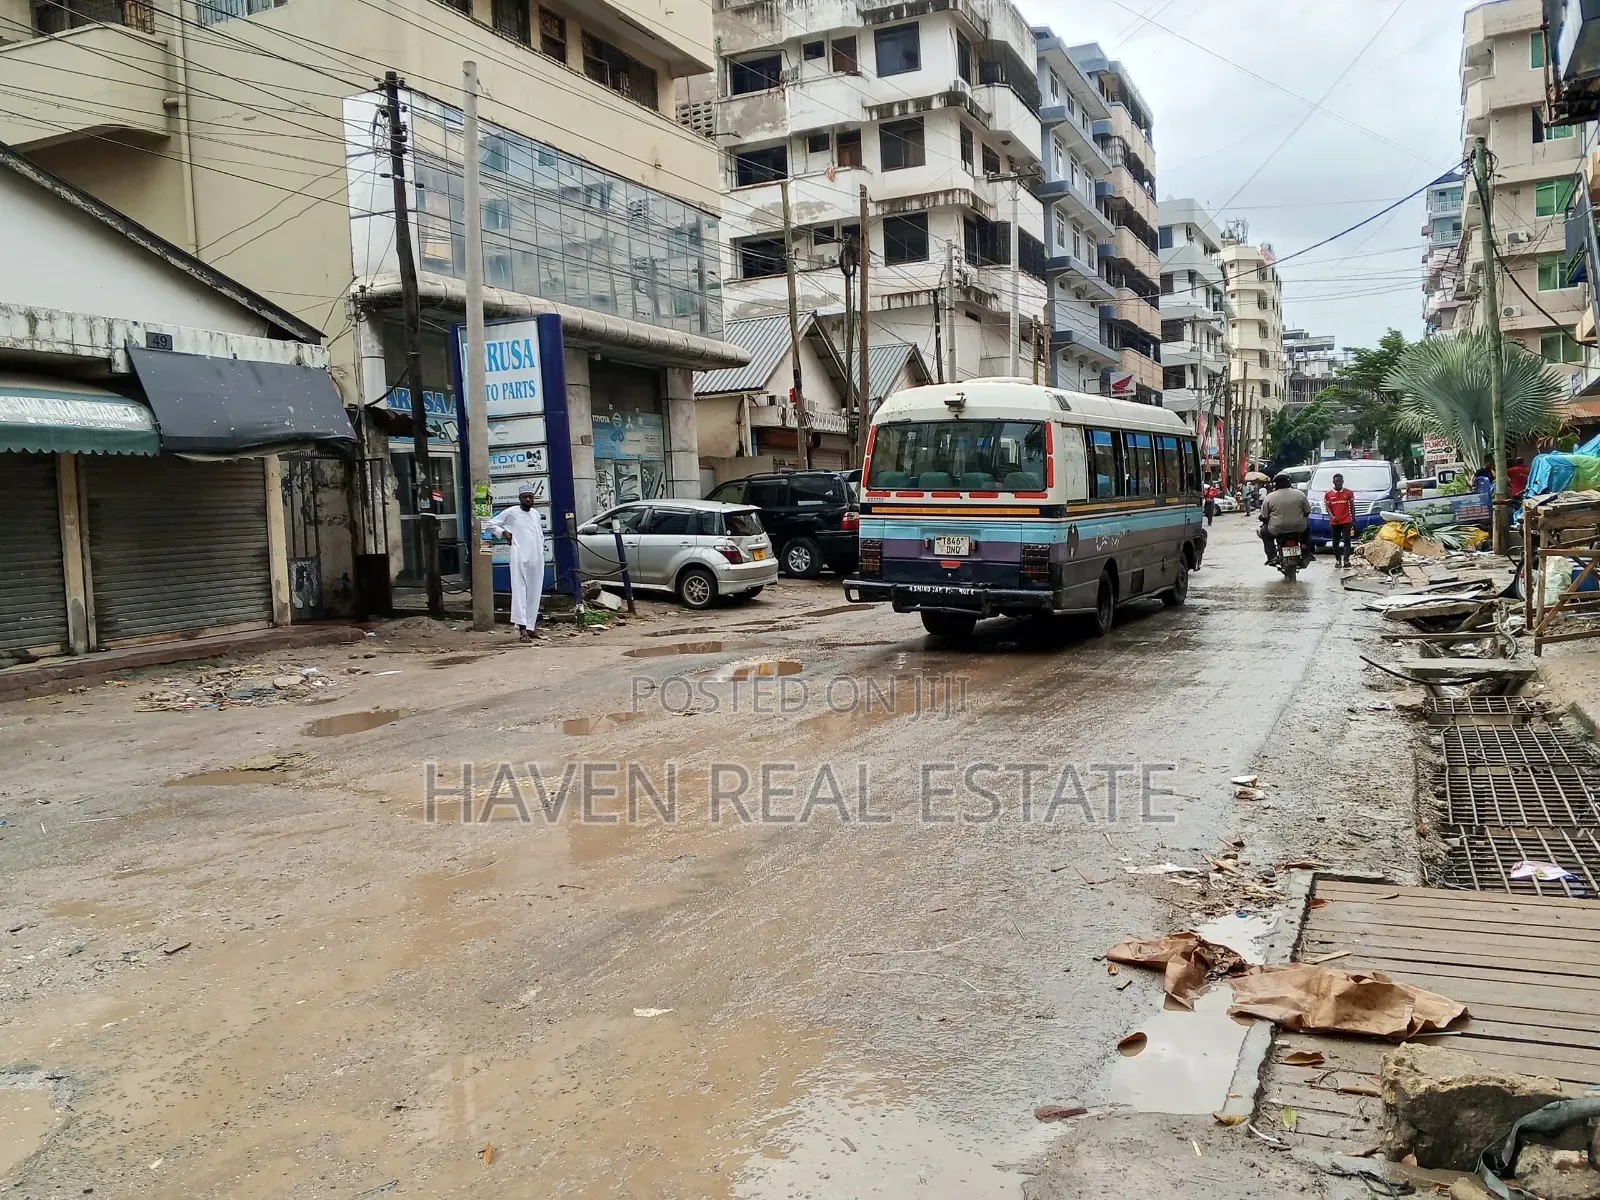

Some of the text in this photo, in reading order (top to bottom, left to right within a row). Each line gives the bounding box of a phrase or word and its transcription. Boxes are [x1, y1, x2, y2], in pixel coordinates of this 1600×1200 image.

[152, 335, 168, 348] 49
[463, 338, 536, 373] RUSA
[501, 379, 536, 400] PARTS
[591, 414, 611, 424] TOYOTA
